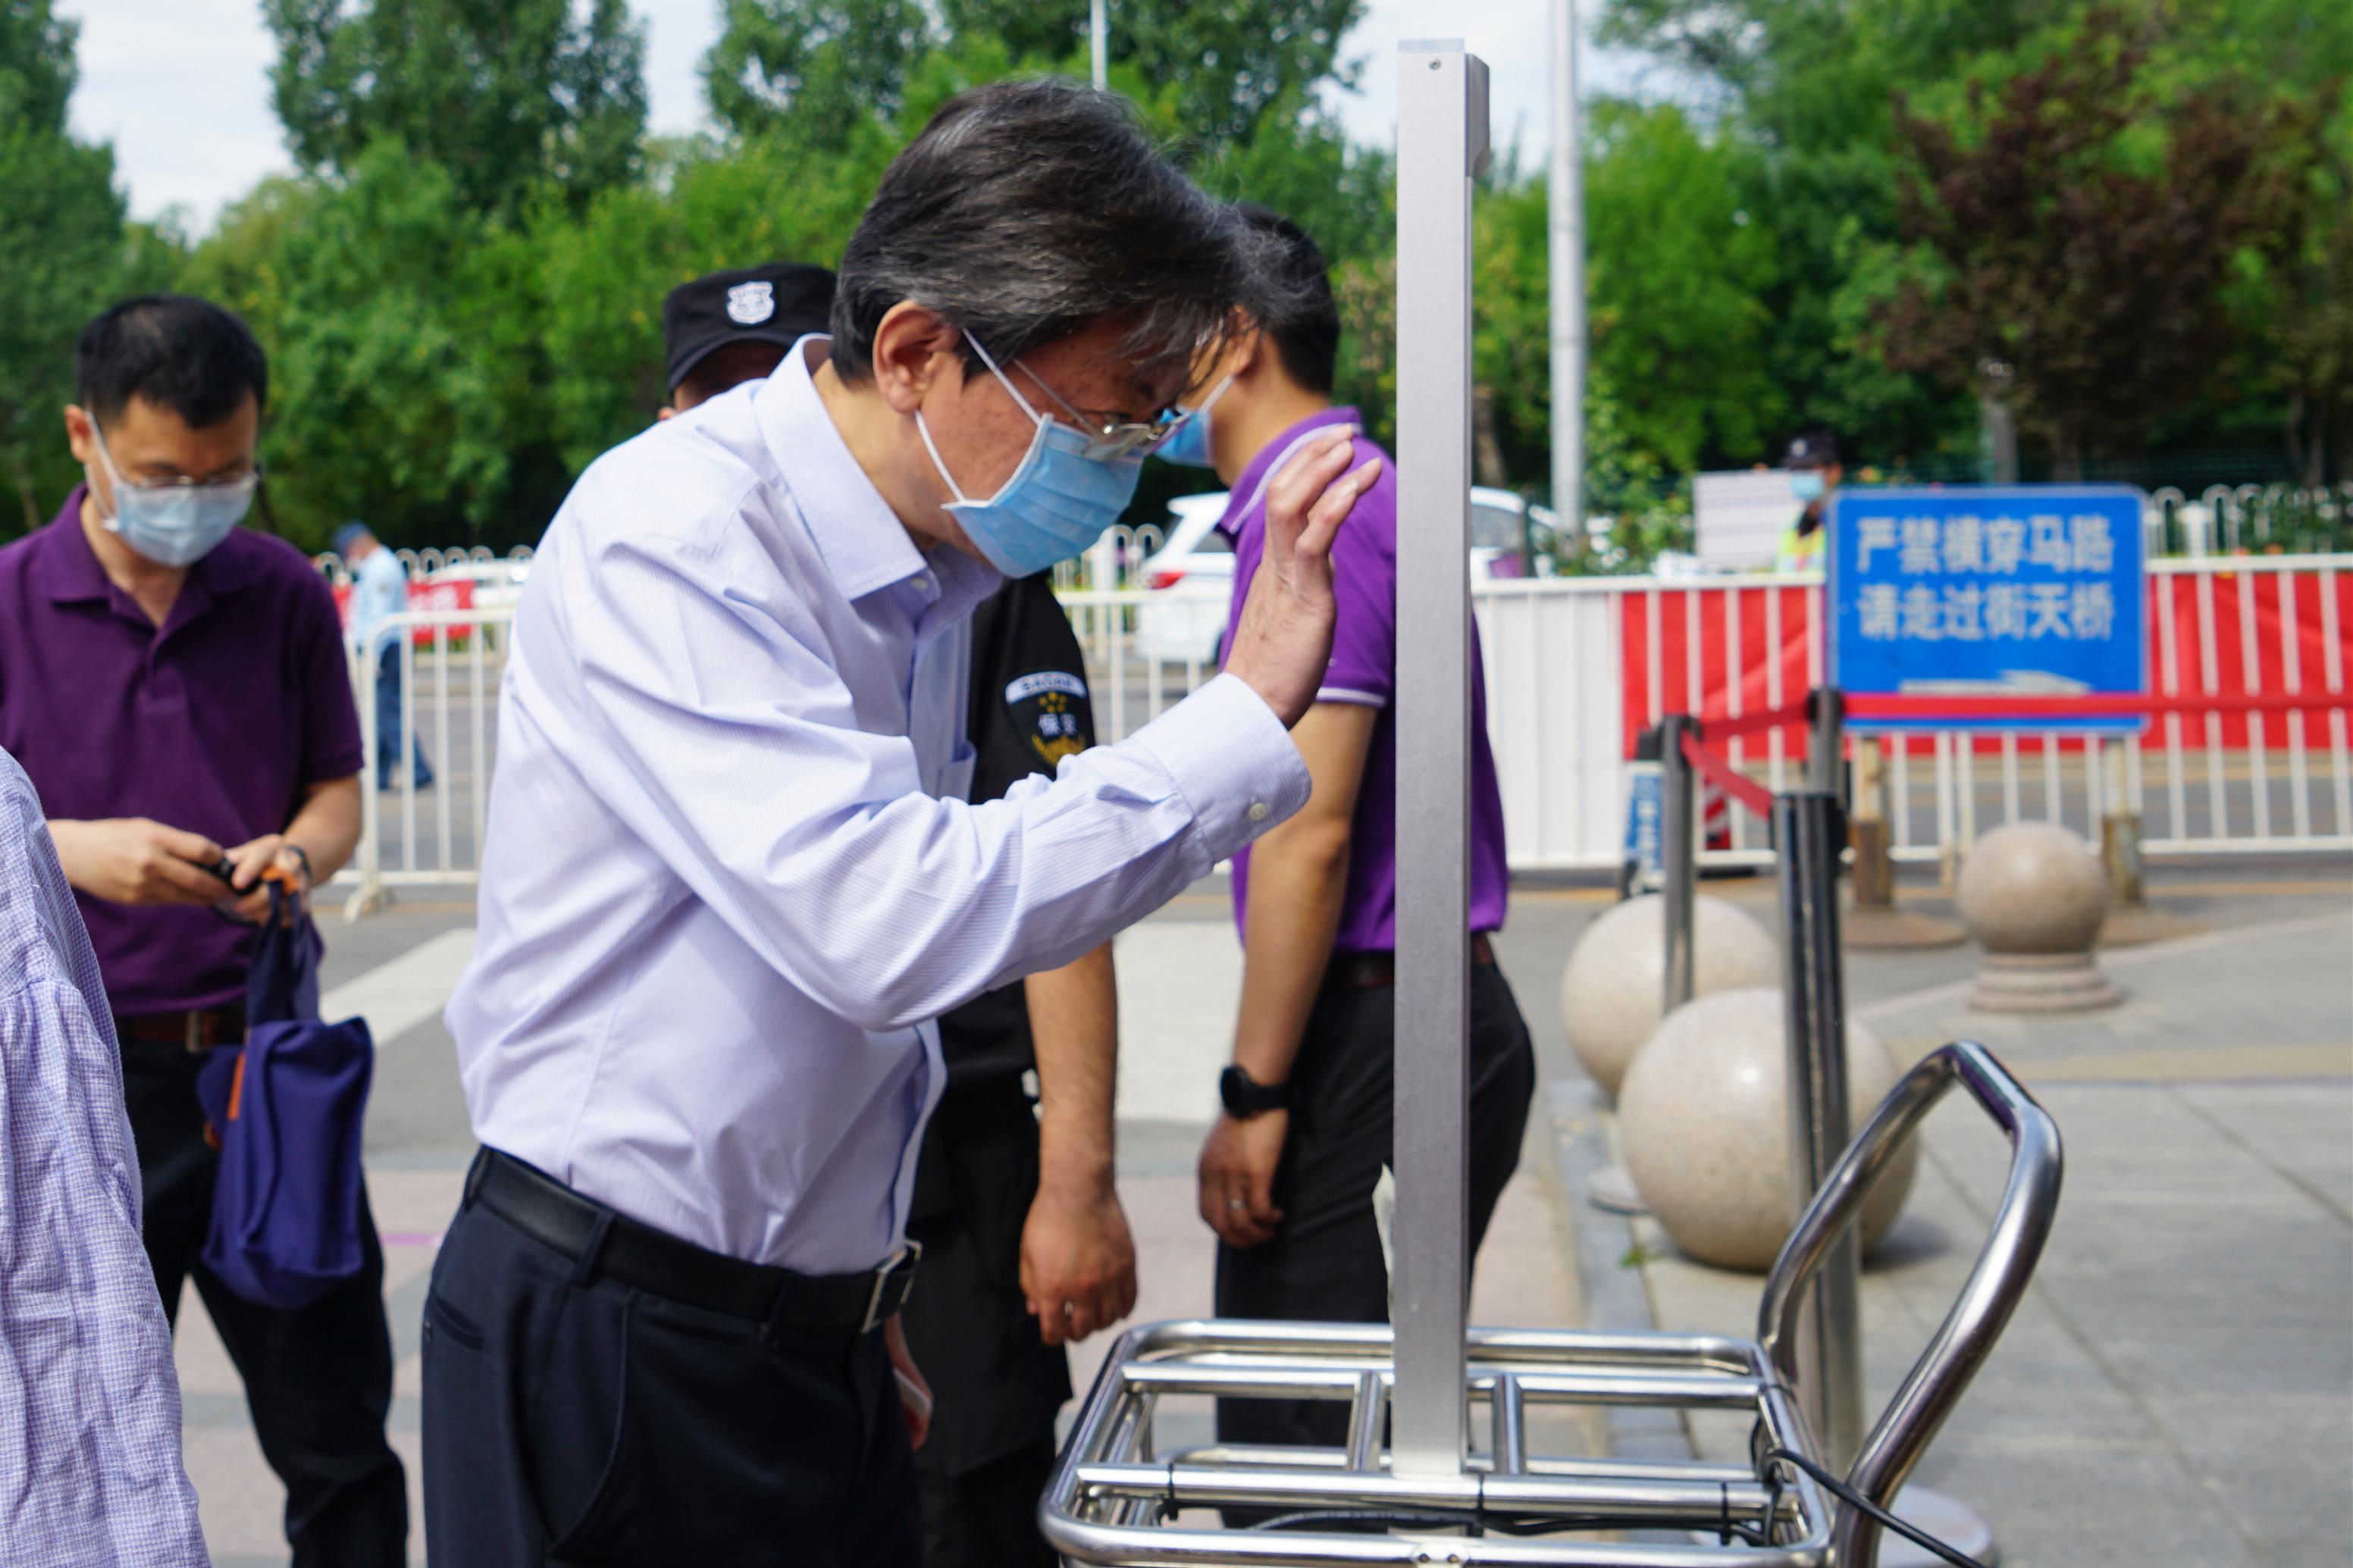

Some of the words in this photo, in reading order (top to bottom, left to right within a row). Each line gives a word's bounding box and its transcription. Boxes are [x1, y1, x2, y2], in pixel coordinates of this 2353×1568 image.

[1857, 513, 2113, 574] 严禁横穿马路
[1857, 581, 2114, 640] 请走过街天桥
